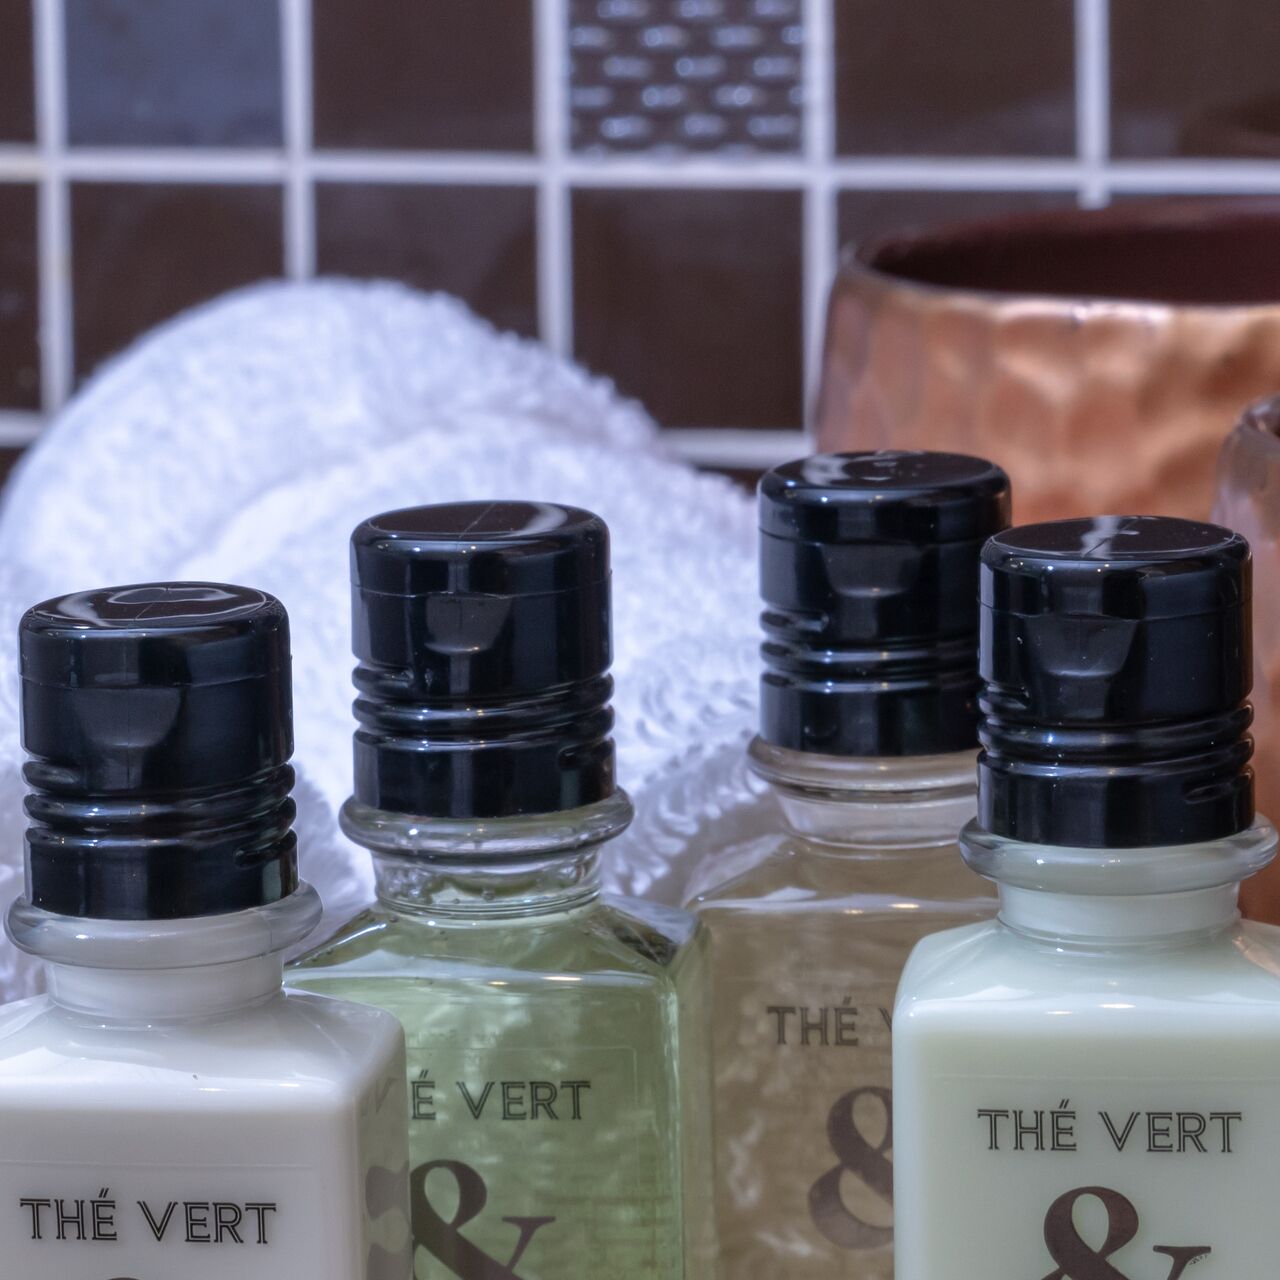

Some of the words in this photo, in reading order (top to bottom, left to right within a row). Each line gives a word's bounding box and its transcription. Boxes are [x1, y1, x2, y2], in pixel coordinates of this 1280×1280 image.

[766, 996, 859, 1047] THÉ
[456, 1080, 591, 1121] VERT
[976, 1098, 1078, 1152] THÉ
[1098, 1111, 1243, 1153] VERT
[19, 1187, 118, 1242] THÉ
[137, 1199, 278, 1245] VERT
